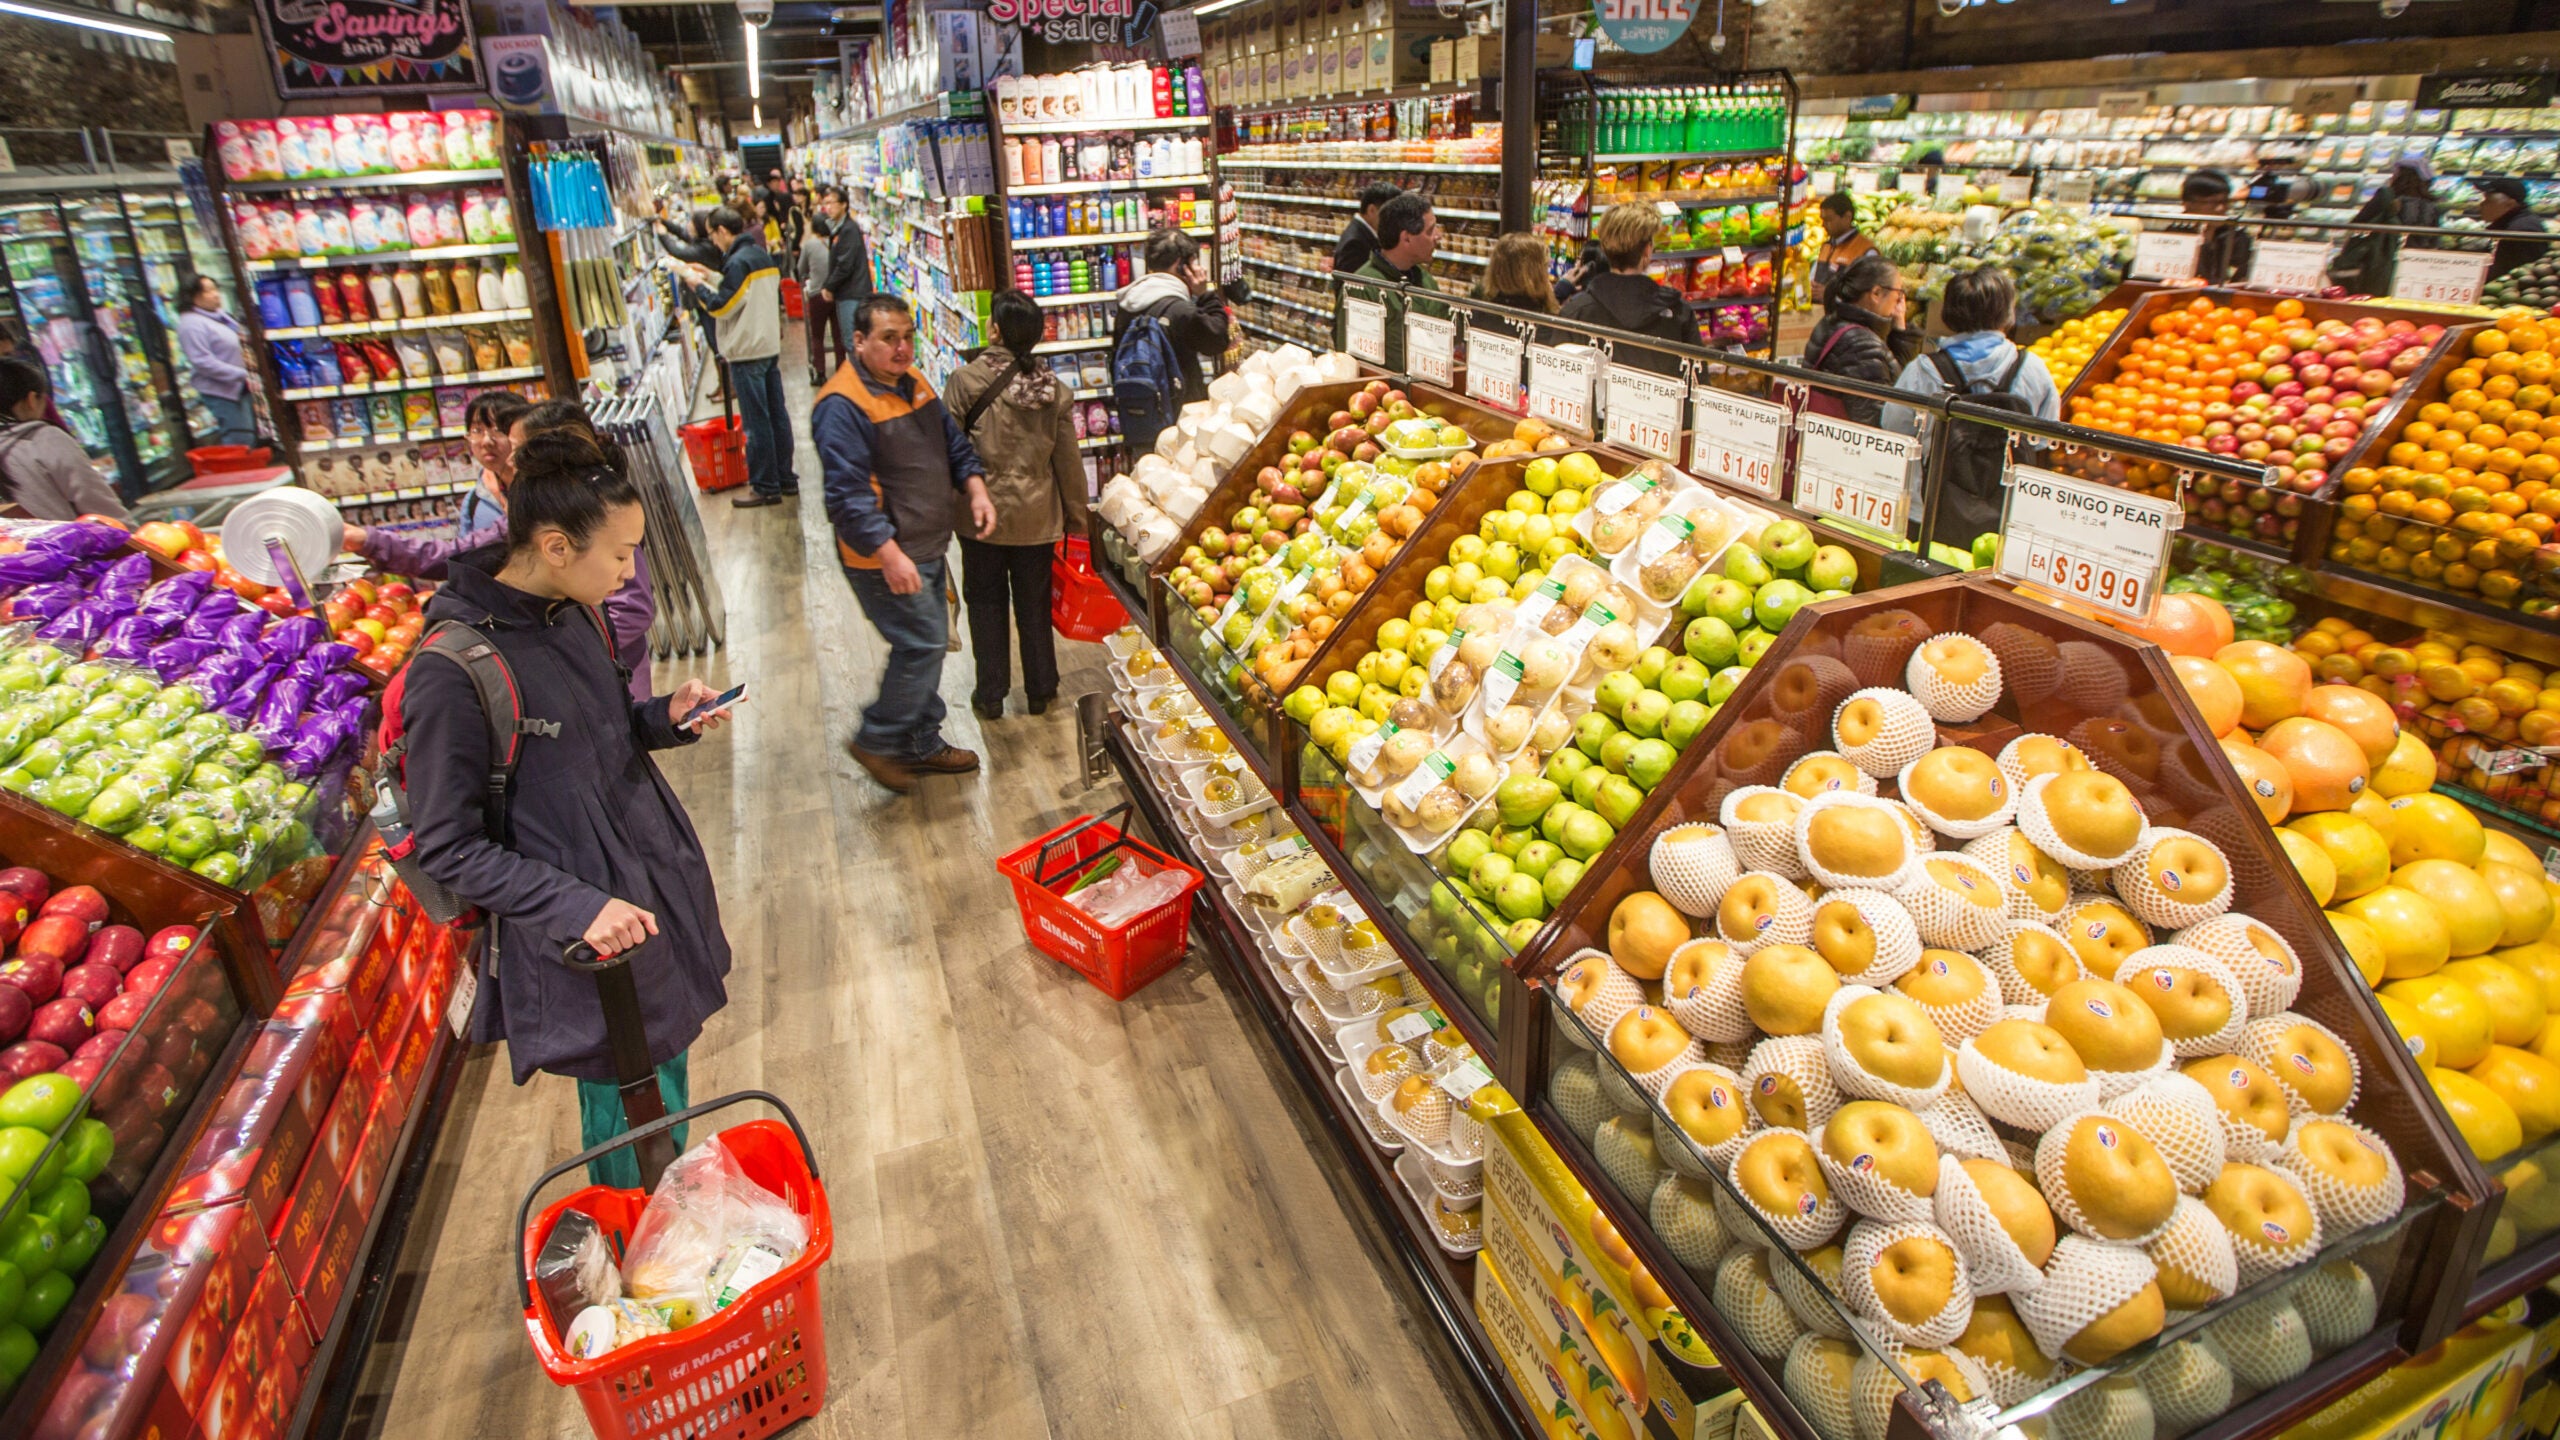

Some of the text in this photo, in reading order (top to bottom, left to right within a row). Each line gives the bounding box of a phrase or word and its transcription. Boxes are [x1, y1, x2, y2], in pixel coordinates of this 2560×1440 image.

[314, 2, 458, 46] Savings
[1045, 13, 1120, 44] sale!
[493, 40, 539, 50] CUCKOO
[2439, 82, 2490, 101] Salad
[2490, 81, 2528, 99] Mix
[1411, 318, 1433, 335] FORELLE
[1472, 336, 1500, 353] Fragrant
[1536, 353, 1558, 368] BOSC
[1560, 359, 1583, 375] PEAR
[1611, 374, 1652, 393] BARTLETT
[1653, 385, 1677, 400] PEAR
[1699, 398, 1733, 415] CHINESE
[1735, 407, 1753, 420] YALI
[1754, 412, 1778, 426] PEAR
[1697, 445, 1706, 458] LB
[1807, 421, 1862, 446] DANJOU
[1865, 435, 1905, 457] PEAR
[1803, 481, 1813, 494] LB
[2017, 480, 2162, 528] KOR SINGO PEAR
[2031, 554, 2046, 570] EA
[1050, 921, 1086, 953] MART
[261, 1130, 293, 1199] Apple
[1518, 1127, 1582, 1210] PRODUCE OF KOREA
[1492, 1147, 1550, 1234] CHEON-AN
[1492, 1162, 1528, 1222] PEARS
[294, 1179, 324, 1249] Apple
[321, 1223, 348, 1294] Apple
[1491, 1231, 1527, 1292] PEARS
[1491, 1217, 1548, 1307] CHEON-AN
[1485, 1294, 1521, 1358] PEARS
[1485, 1281, 1544, 1374] CHEON-AN
[692, 1332, 753, 1372] MART
